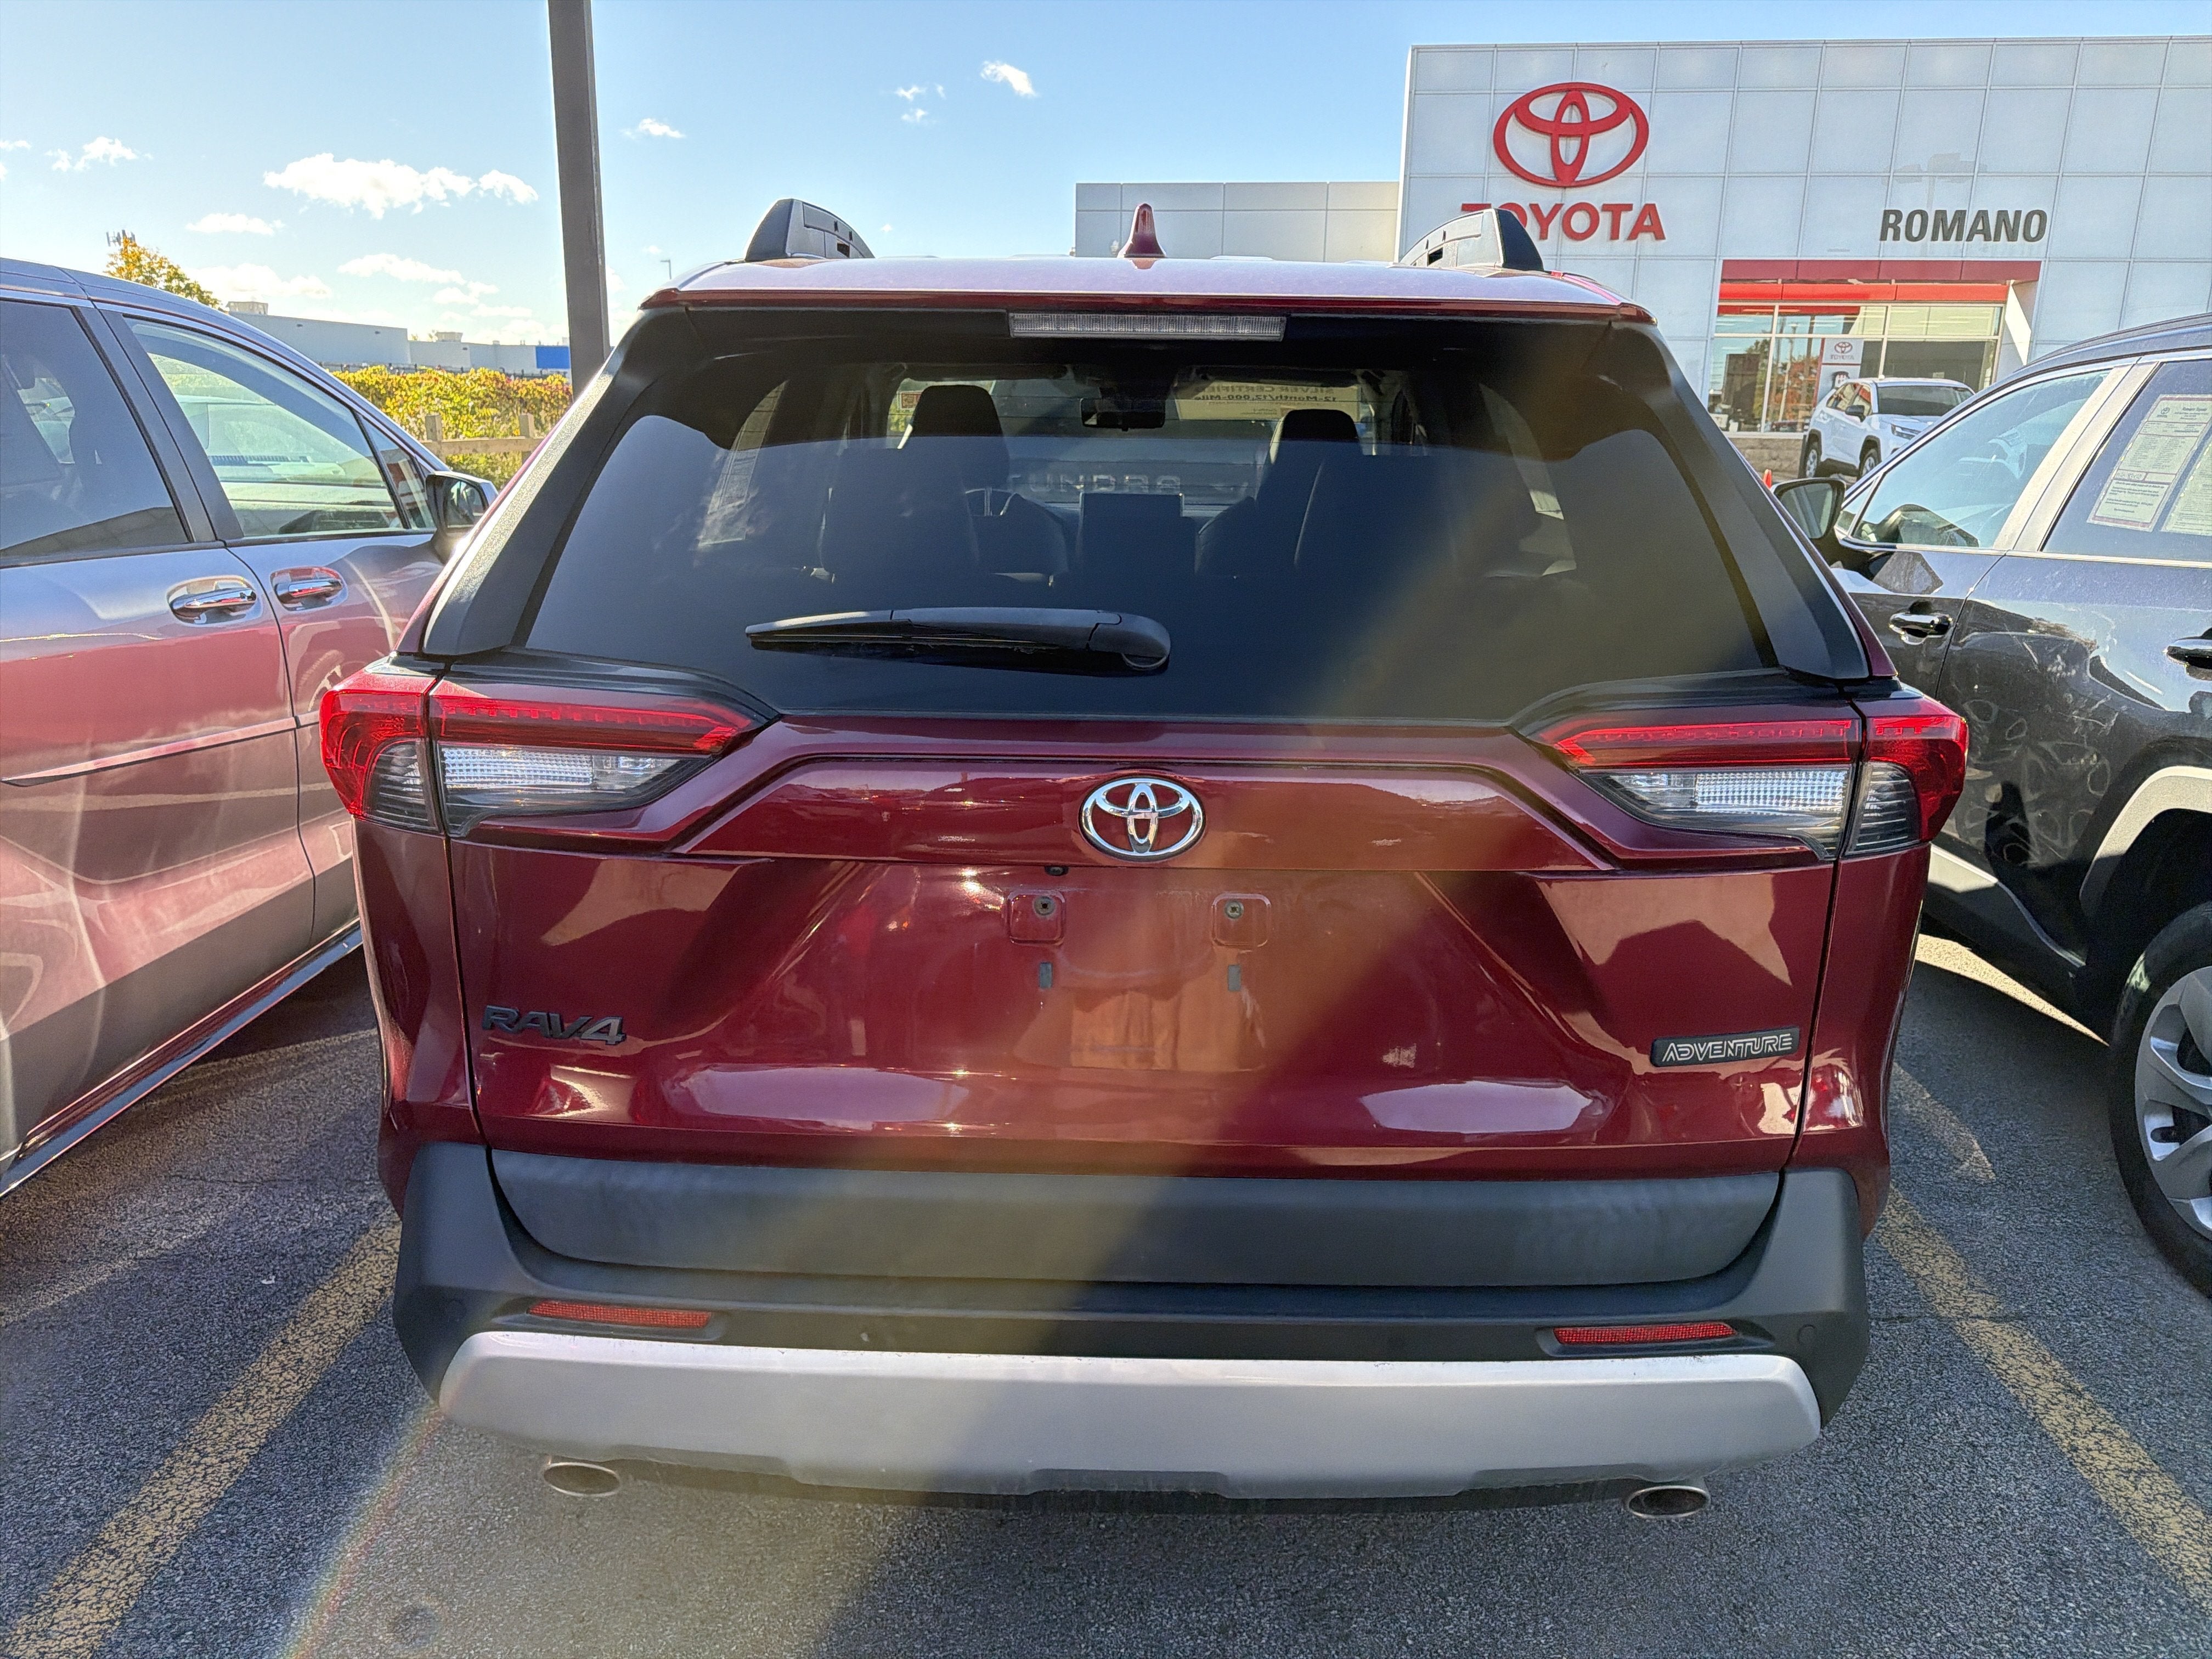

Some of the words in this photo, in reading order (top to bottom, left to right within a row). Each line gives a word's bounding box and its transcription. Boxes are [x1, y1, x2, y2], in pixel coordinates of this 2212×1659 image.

[1880, 209, 2048, 242] ROMANO
[482, 1005, 627, 1046] RAV4
[1662, 1033, 1792, 1062] ADVENTURE
